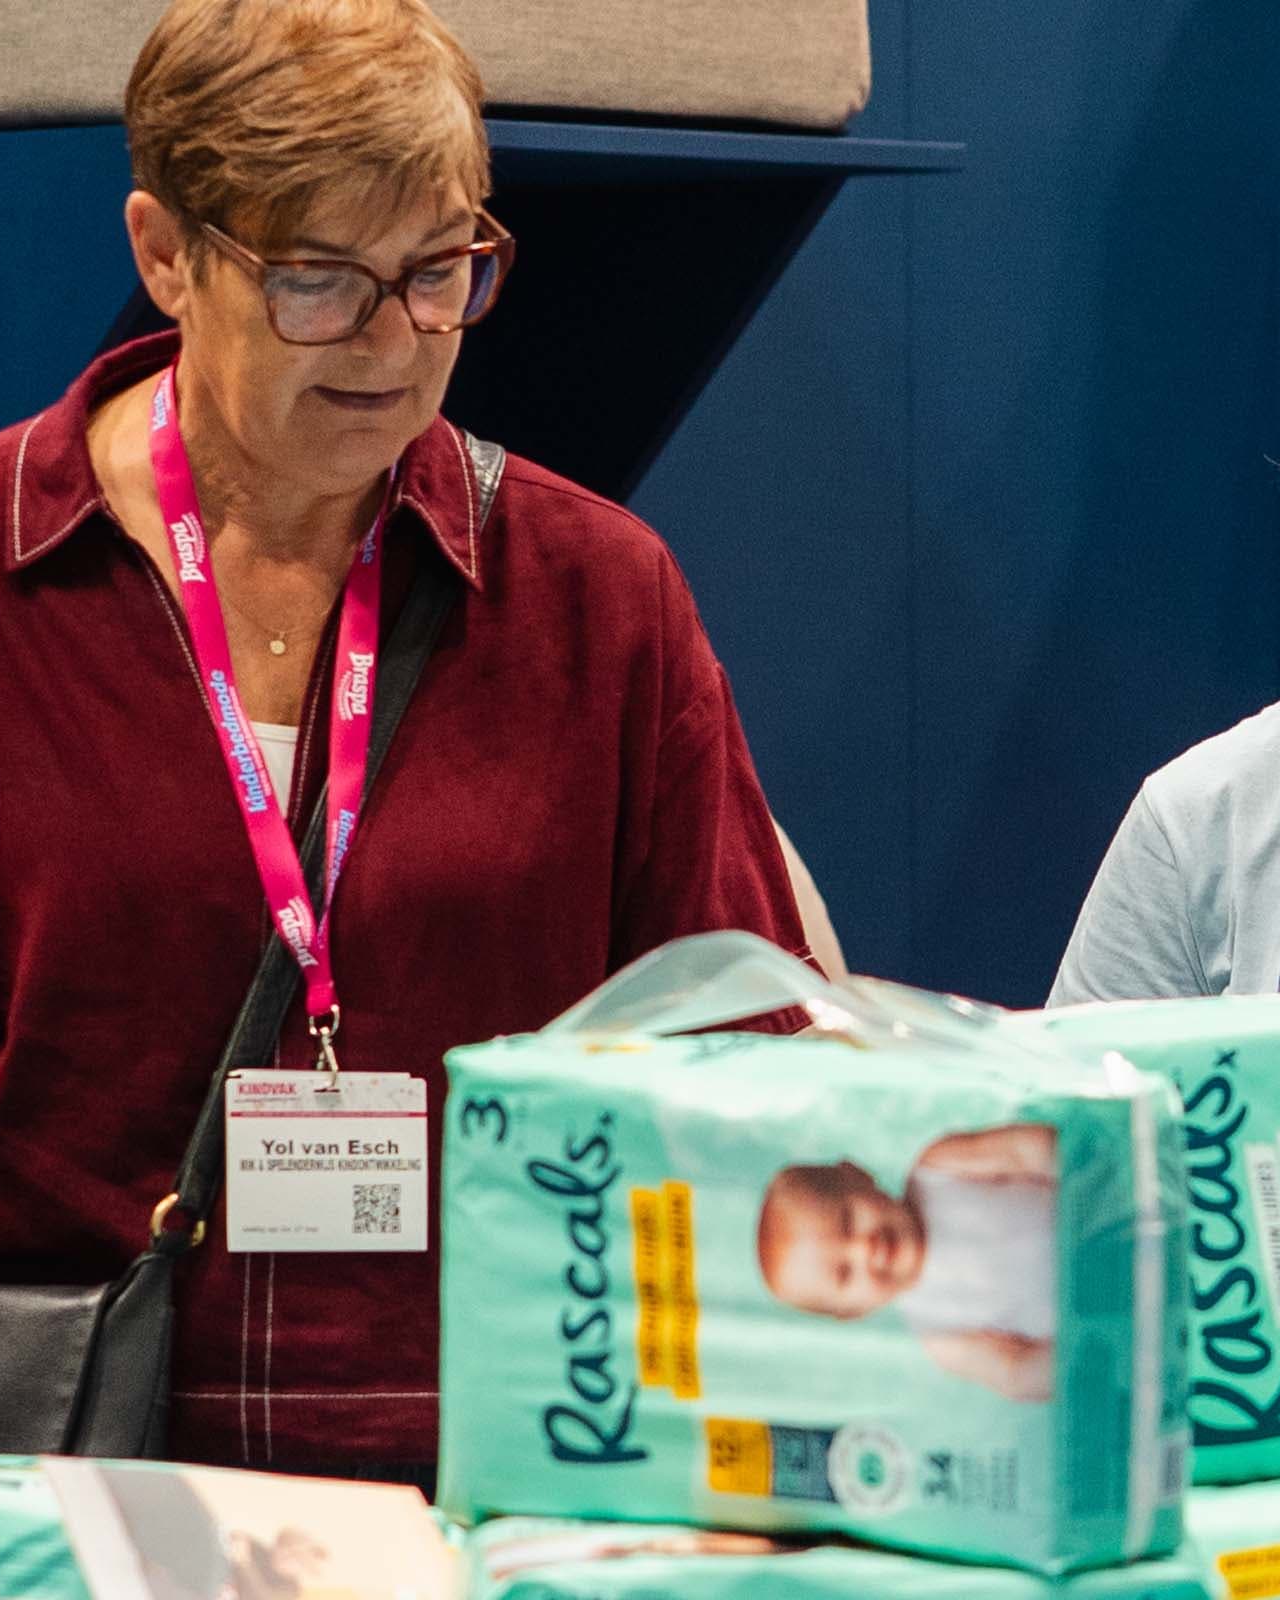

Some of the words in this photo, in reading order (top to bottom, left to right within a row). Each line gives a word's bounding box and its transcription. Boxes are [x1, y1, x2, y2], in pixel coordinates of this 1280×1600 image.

[170, 521, 207, 583] Braspa
[347, 650, 374, 716] Braspa
[276, 906, 318, 966] Braspa
[261, 1139, 294, 1156] Yol
[302, 1142, 340, 1156] van
[348, 1139, 400, 1156] Esch
[460, 1093, 509, 1144] 3
